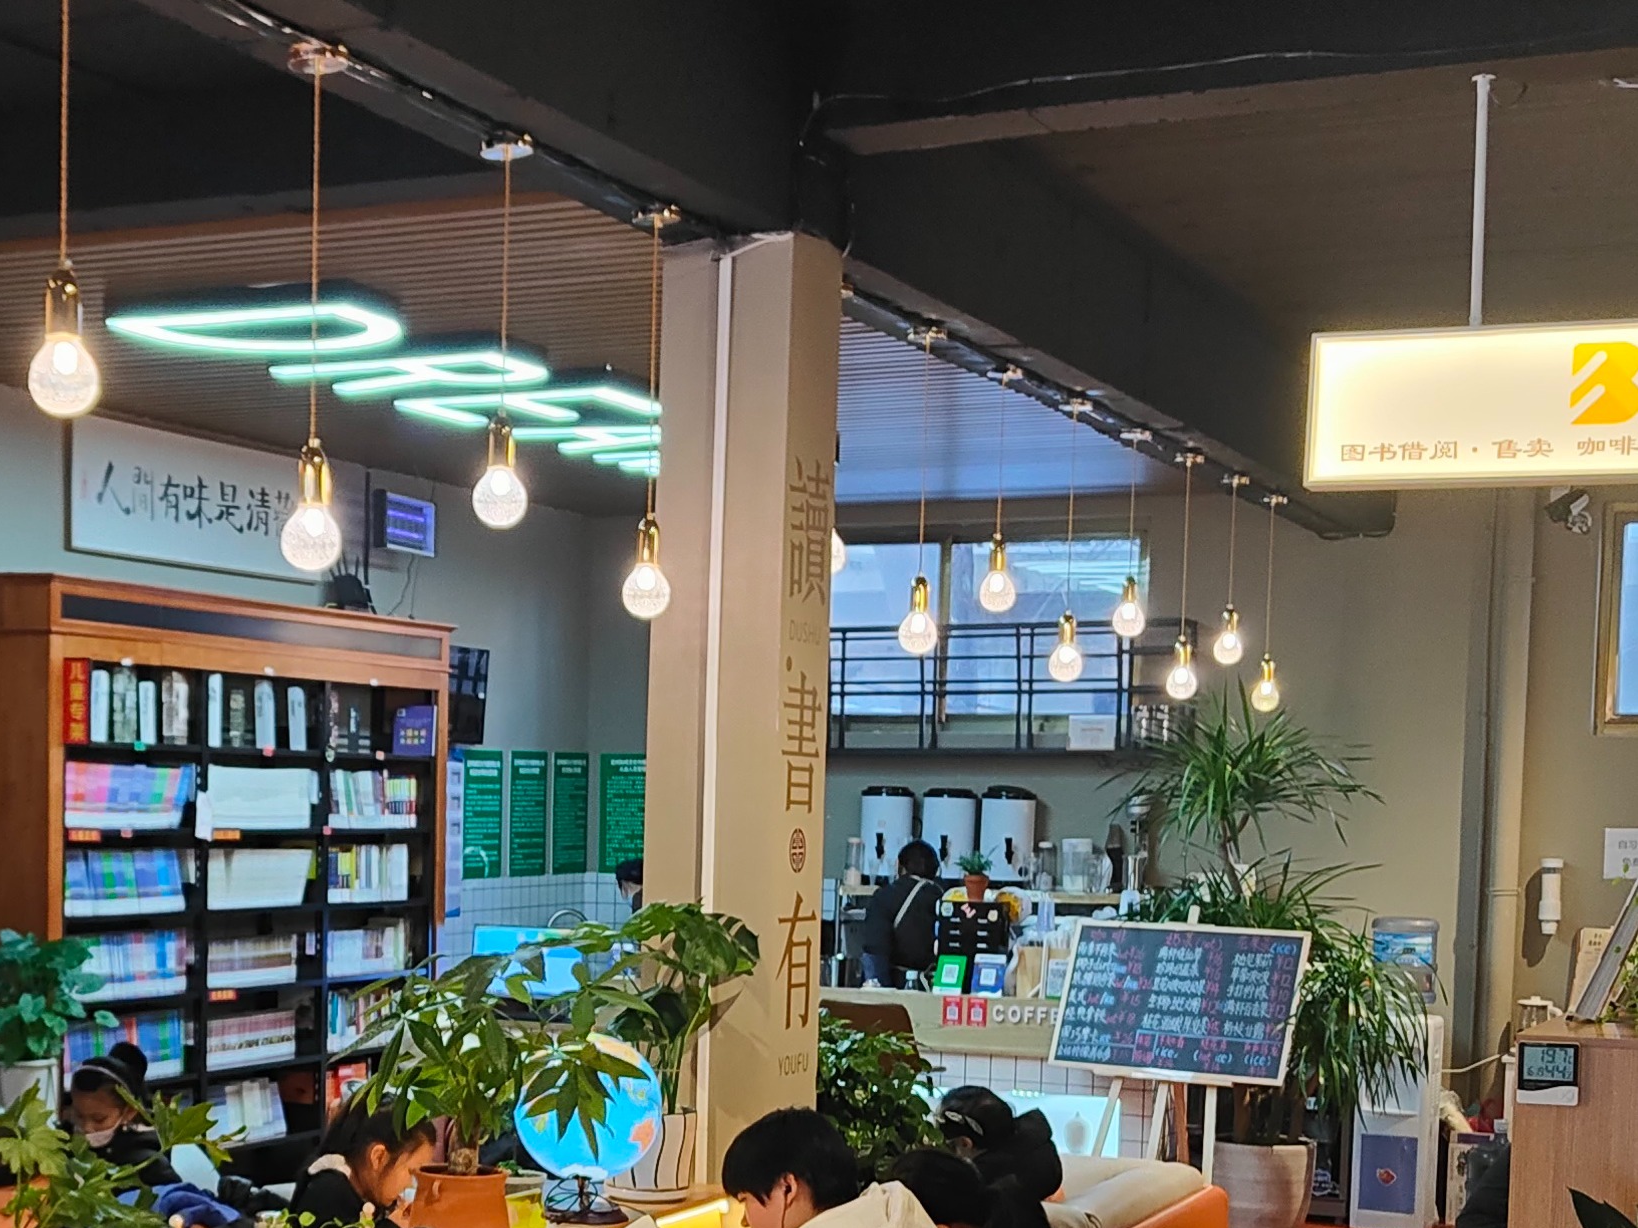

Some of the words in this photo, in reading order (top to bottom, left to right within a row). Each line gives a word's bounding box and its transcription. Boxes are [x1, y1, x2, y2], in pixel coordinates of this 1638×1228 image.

[788, 617, 822, 646] DUSHU
[776, 891, 817, 1030] 有
[992, 1004, 1059, 1024] COFFE
[778, 1051, 809, 1077] YOUFU
